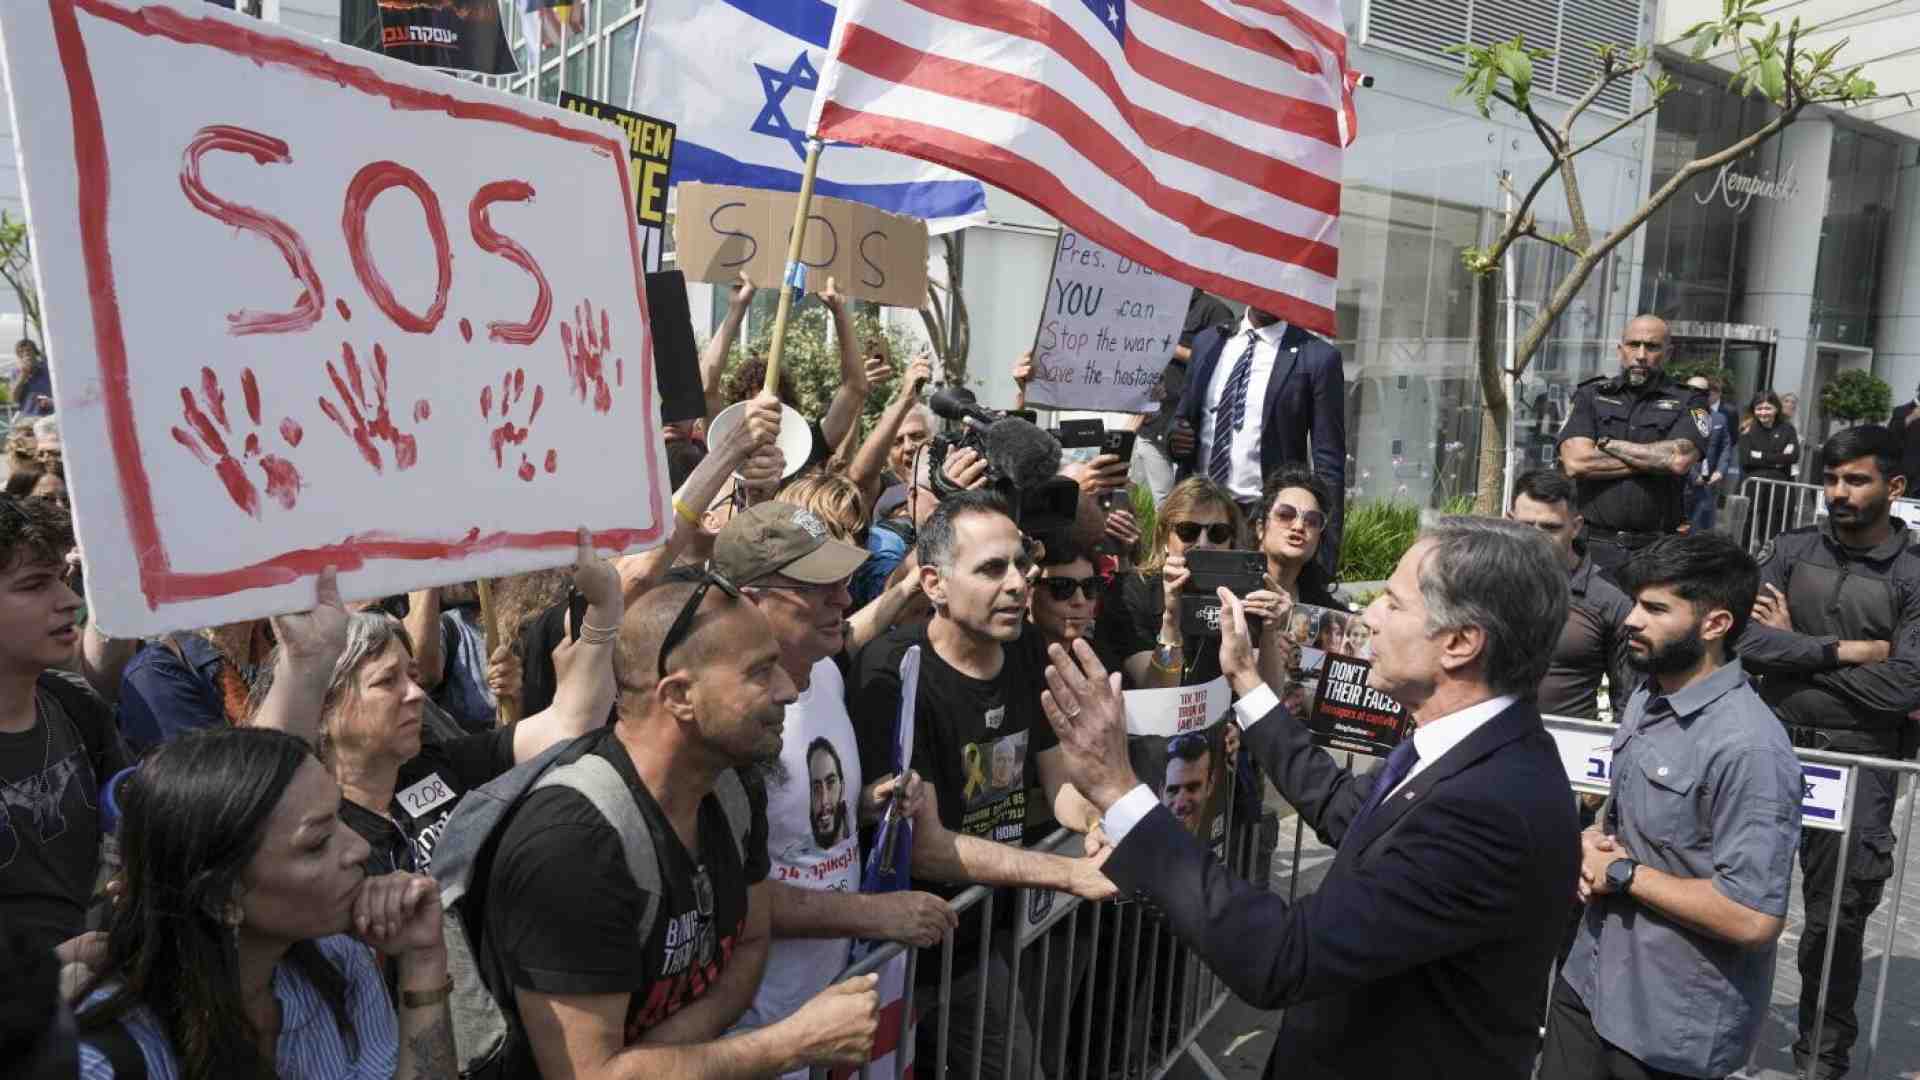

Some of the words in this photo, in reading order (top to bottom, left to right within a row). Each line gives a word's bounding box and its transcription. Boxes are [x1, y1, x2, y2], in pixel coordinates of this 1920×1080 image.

[710, 202, 889, 288] SOS
[1058, 233, 1105, 267] Pres.
[1055, 277, 1104, 317] YOU
[1116, 299, 1155, 320] can
[1039, 320, 1089, 355] Stop
[1096, 326, 1116, 352] the
[1124, 335, 1155, 352] war
[1039, 351, 1075, 384] Save
[1083, 359, 1103, 385] the
[1329, 661, 1366, 683] DON'T
[1324, 679, 1363, 706] THEIR
[408, 780, 446, 809] 208
[995, 824, 1024, 841] HOME
